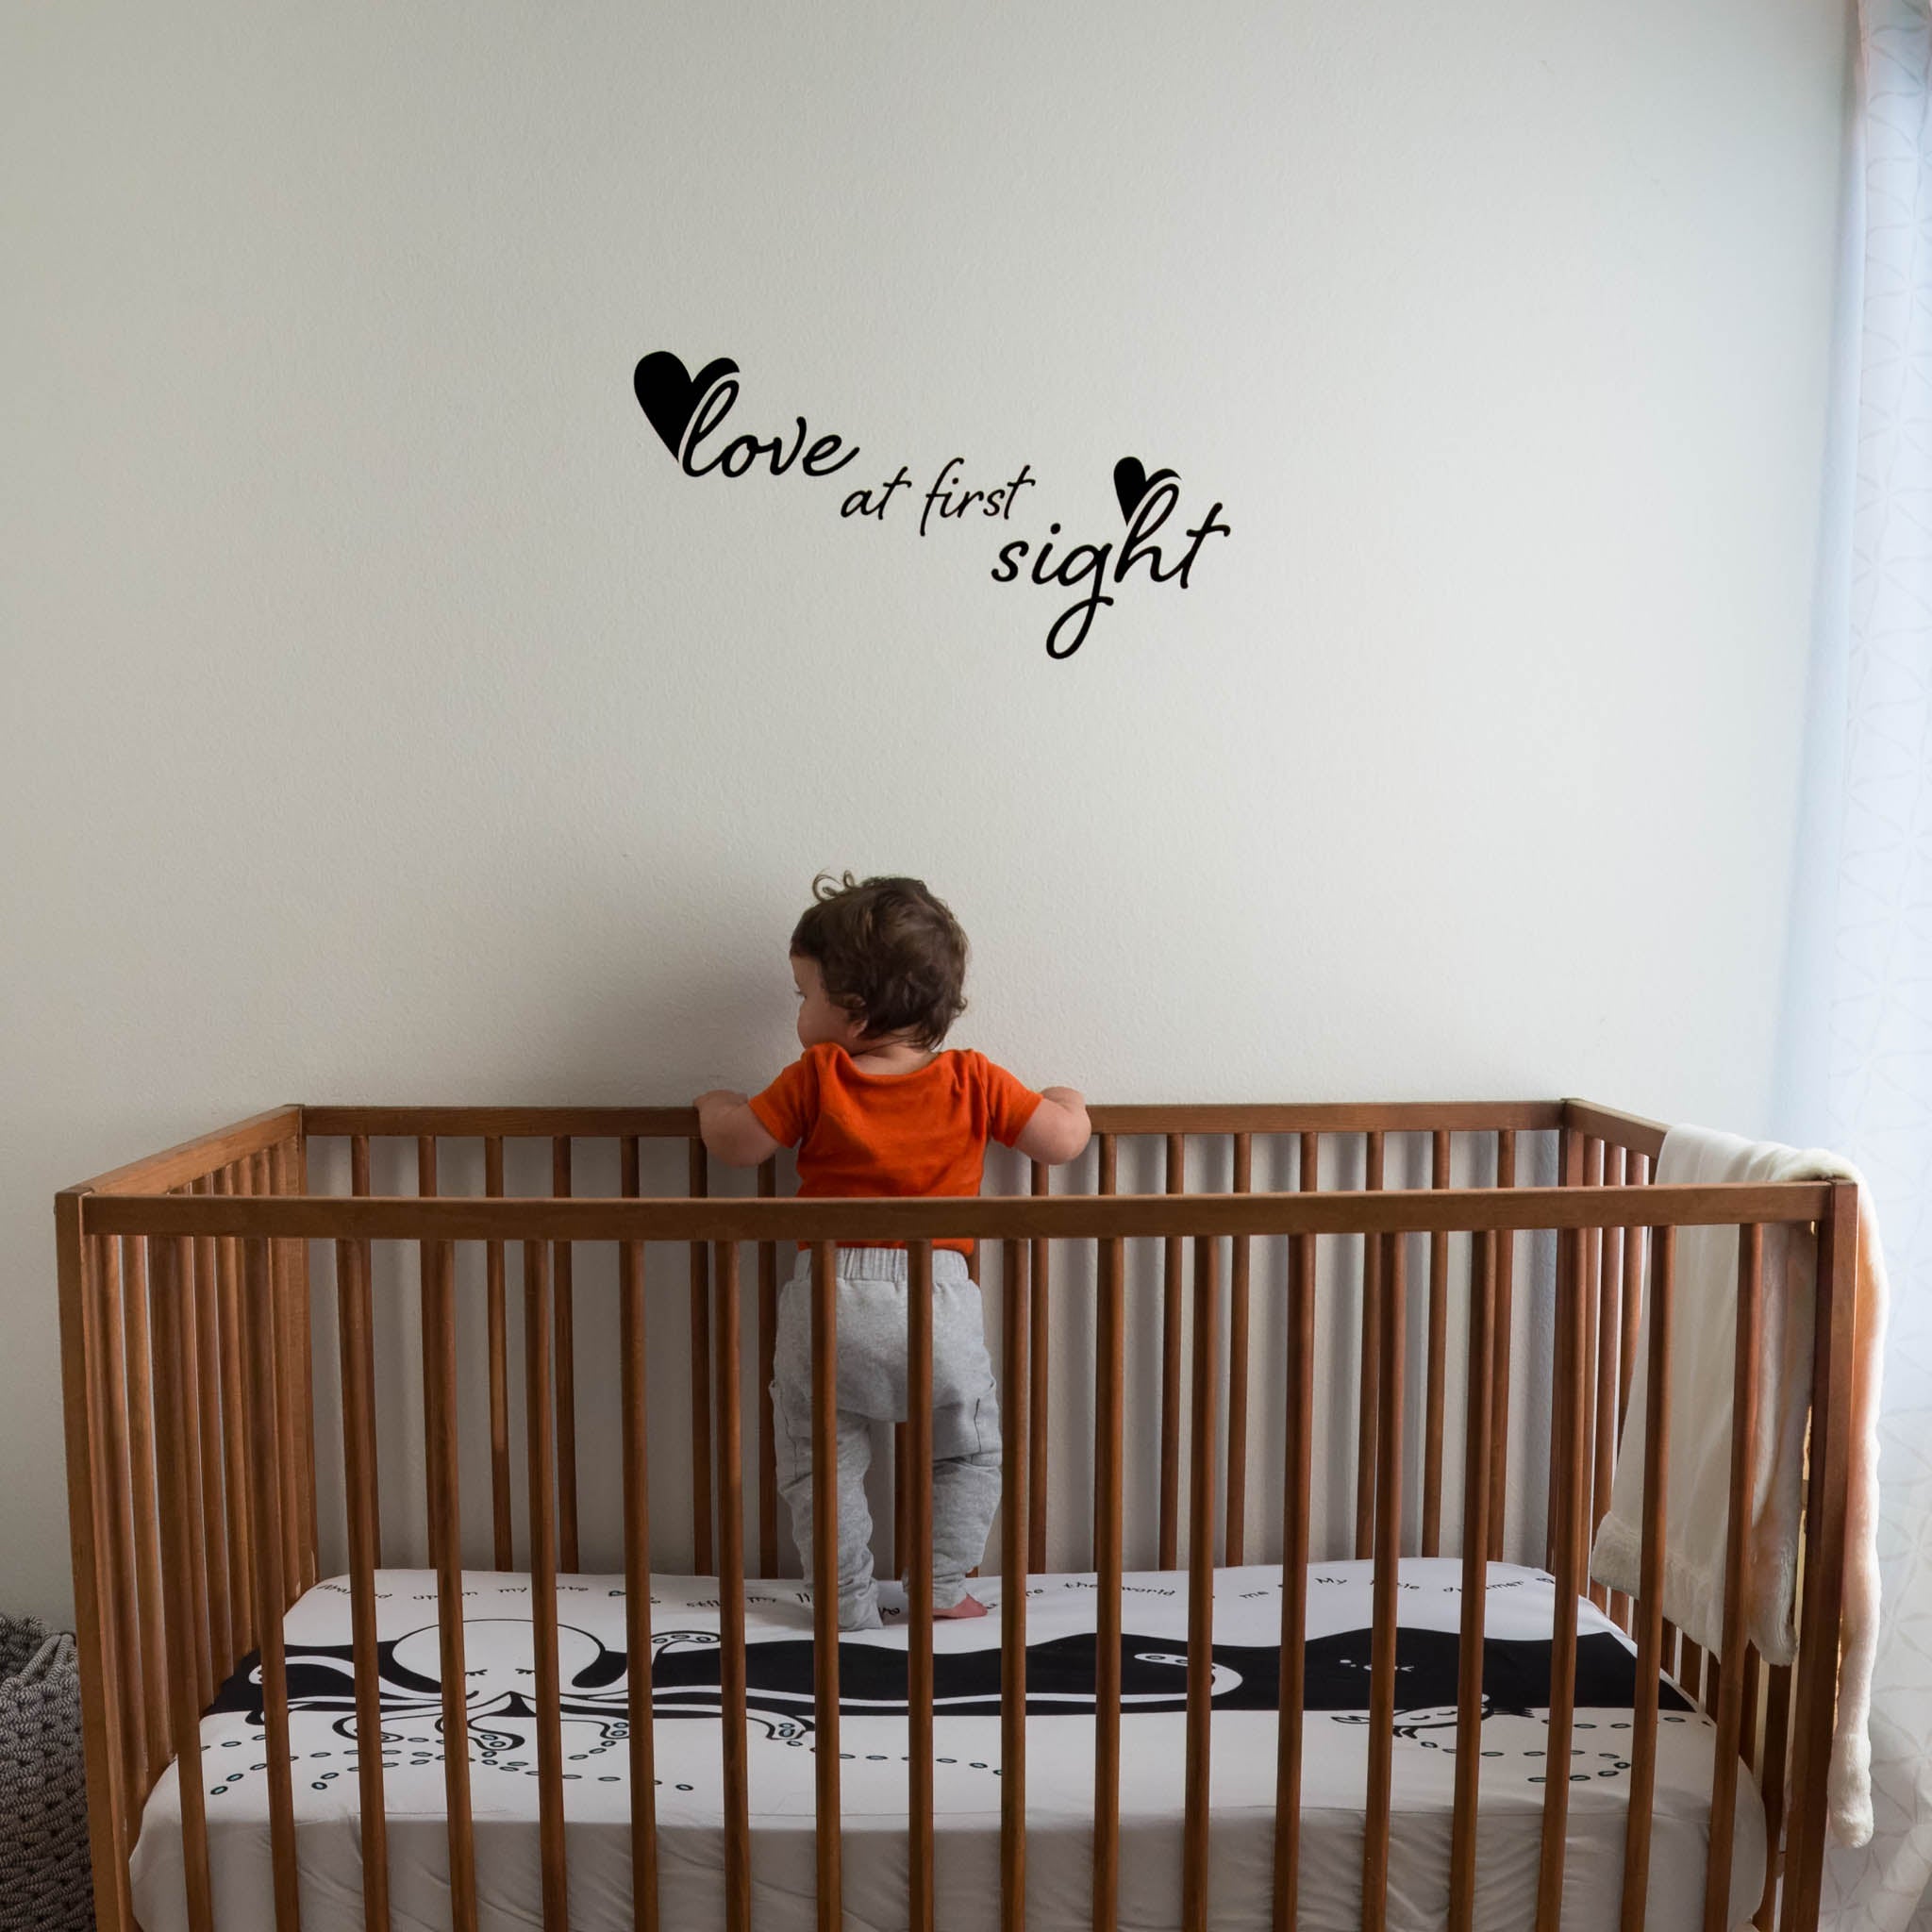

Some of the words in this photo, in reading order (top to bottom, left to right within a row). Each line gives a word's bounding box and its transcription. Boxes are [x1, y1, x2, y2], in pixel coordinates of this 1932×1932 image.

[681, 379, 860, 477] love
[841, 466, 912, 520] at
[919, 457, 1036, 537] first
[991, 475, 1231, 660] sight
[1314, 1577, 1348, 1586] My
